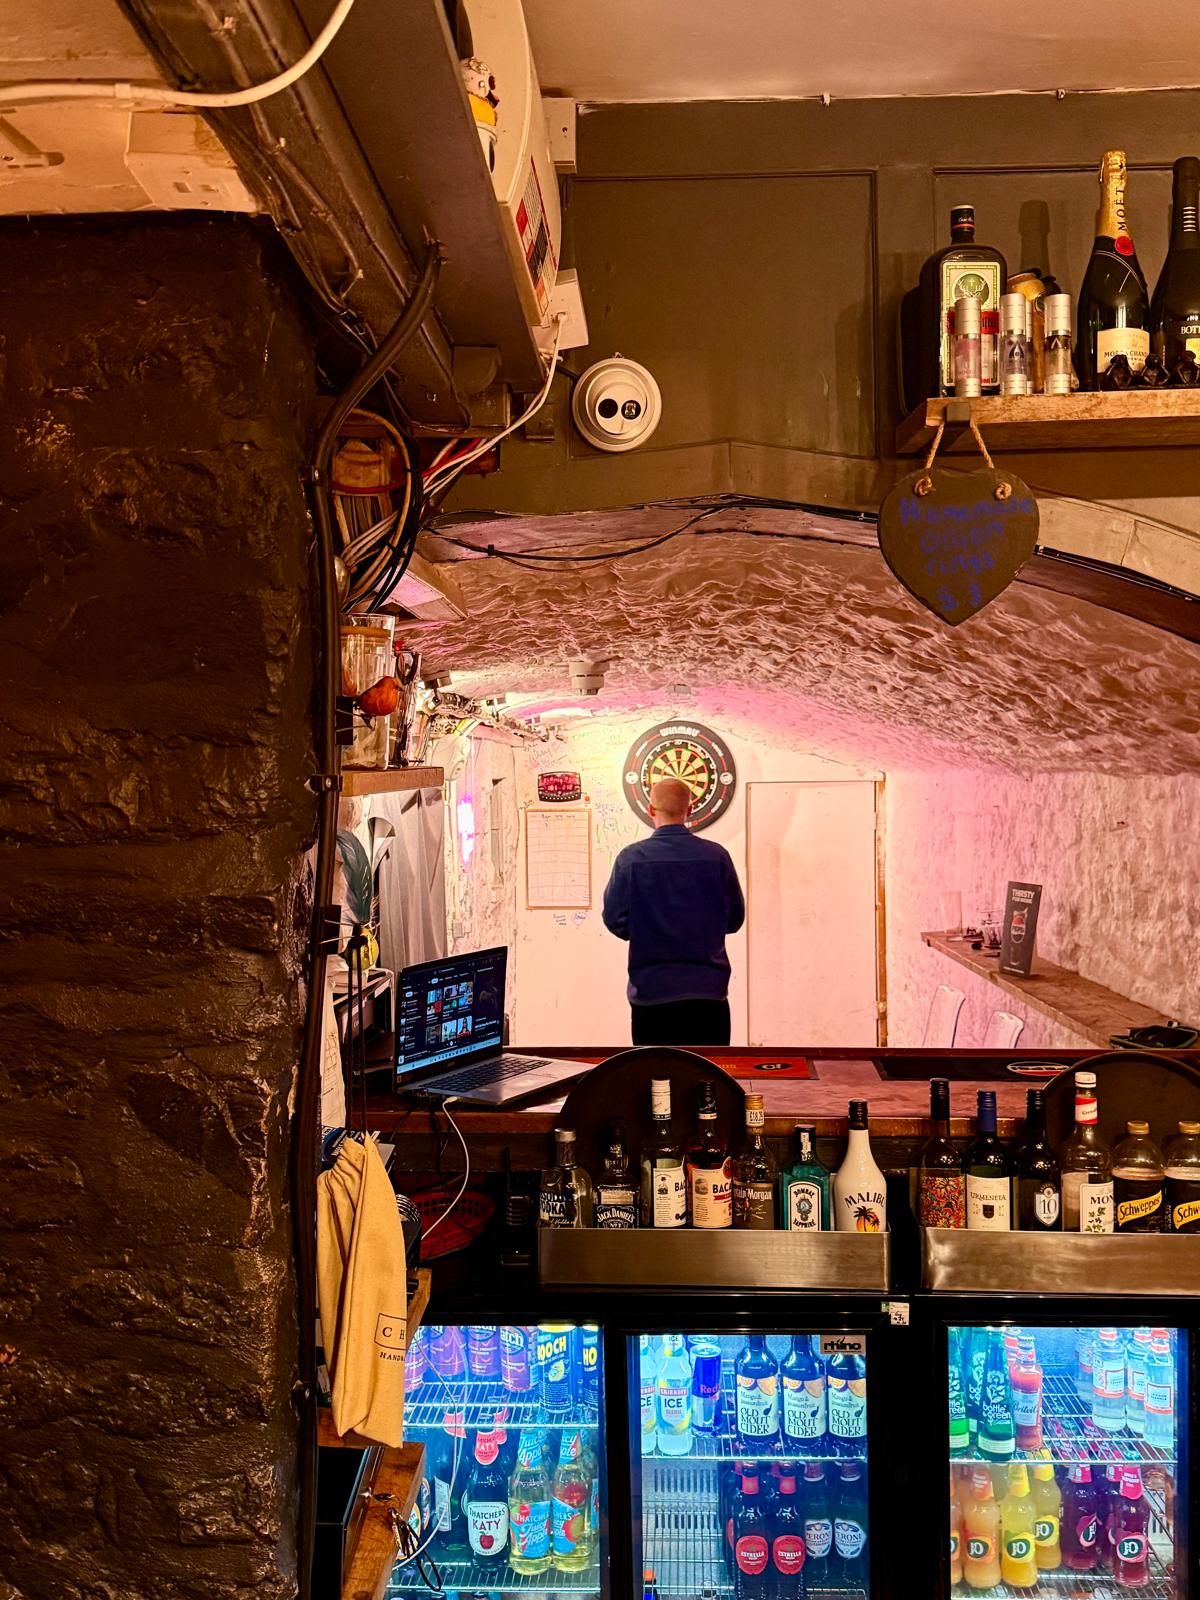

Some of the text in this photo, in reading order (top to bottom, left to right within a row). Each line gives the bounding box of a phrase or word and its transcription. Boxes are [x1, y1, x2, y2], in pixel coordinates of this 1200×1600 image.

[660, 726, 700, 737] WINMAU
[749, 1188, 772, 1201] Morgan
[1040, 1199, 1057, 1214] 10
[1120, 1197, 1160, 1220] Schweppes
[501, 1329, 524, 1348] atch
[823, 1336, 862, 1350] rhino
[641, 1396, 652, 1408] CE
[664, 1398, 683, 1408] ICE
[983, 1401, 1005, 1412] bottle
[740, 1407, 759, 1417] OLD
[787, 1409, 806, 1419] OLD
[831, 1408, 850, 1418] OLD
[741, 1415, 770, 1424] MOUT
[787, 1417, 818, 1426] MOUT
[832, 1416, 862, 1426] MOUT
[740, 1423, 770, 1434] CIDER
[787, 1425, 817, 1436] CIDER
[831, 1424, 861, 1436] CIDER
[469, 1508, 506, 1520] THATCHERS
[472, 1519, 501, 1531] KATY
